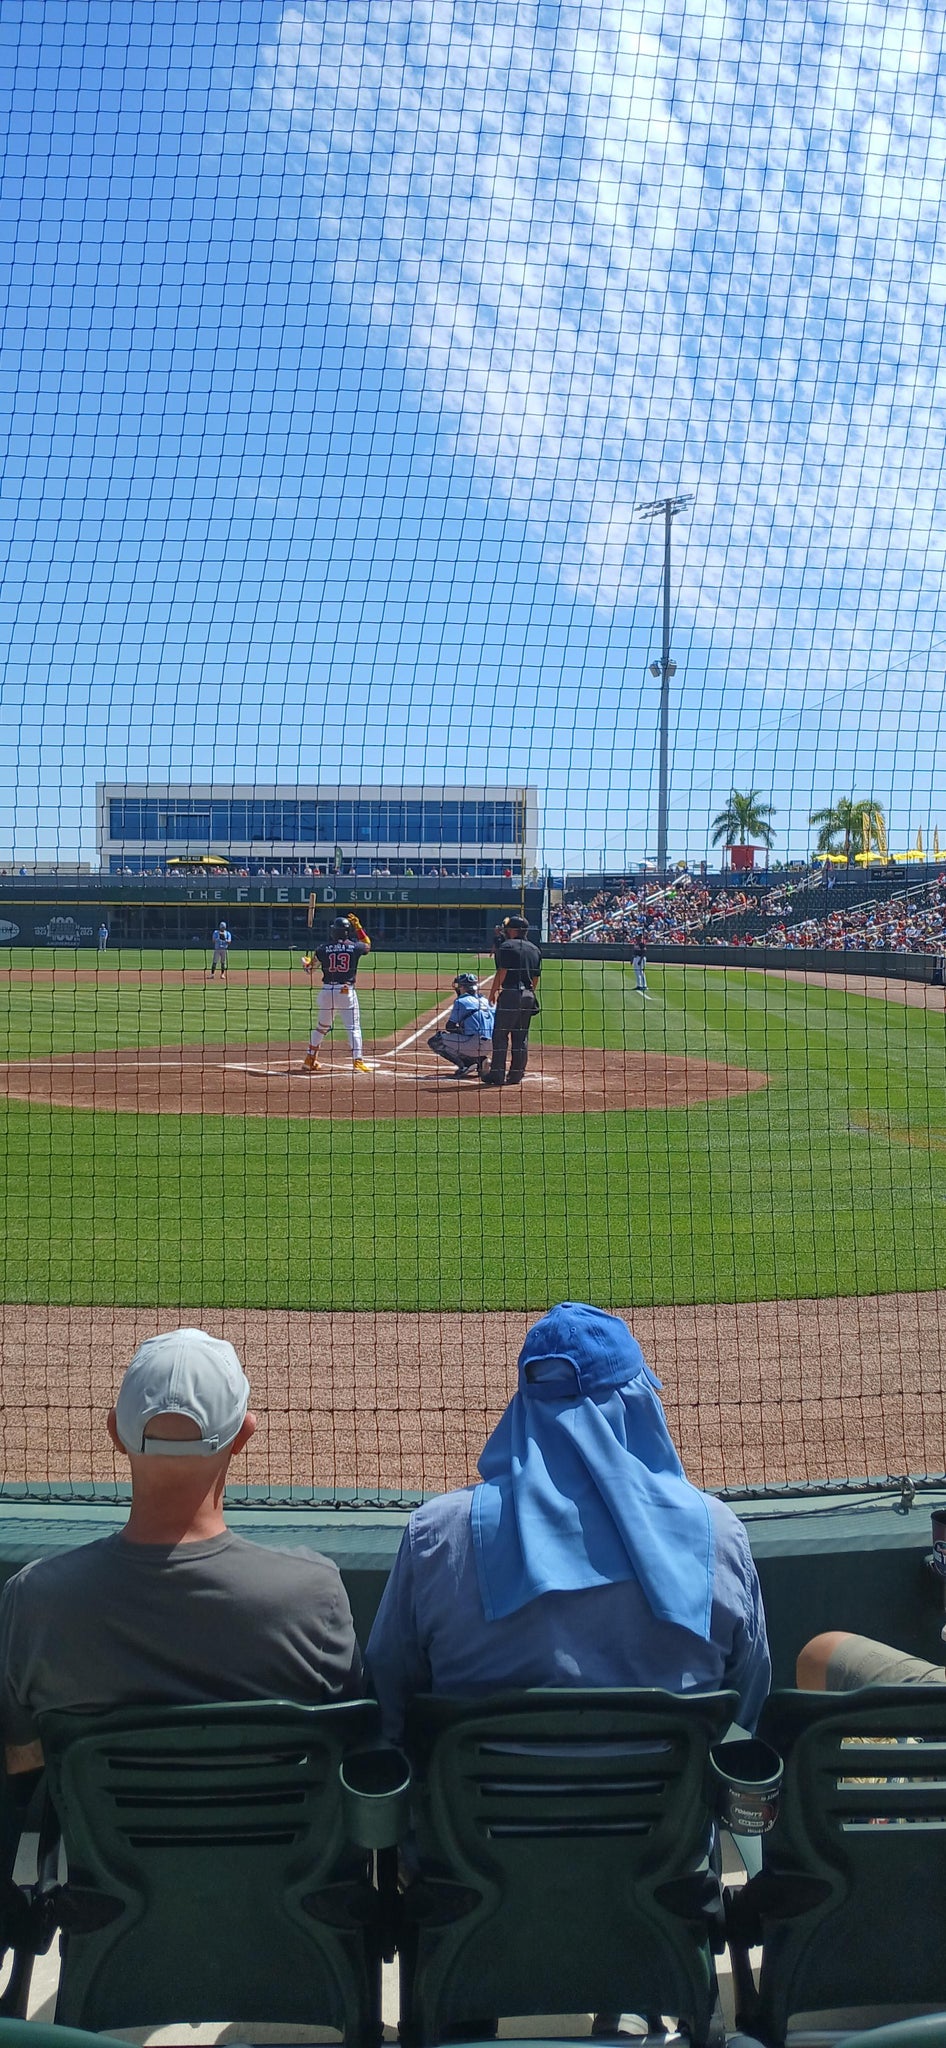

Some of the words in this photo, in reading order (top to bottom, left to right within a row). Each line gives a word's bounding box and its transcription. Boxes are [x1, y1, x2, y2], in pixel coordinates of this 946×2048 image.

[187, 890, 221, 899] THE
[236, 888, 335, 902] FIELD
[350, 891, 409, 900] SUITE
[328, 952, 351, 973] 13
